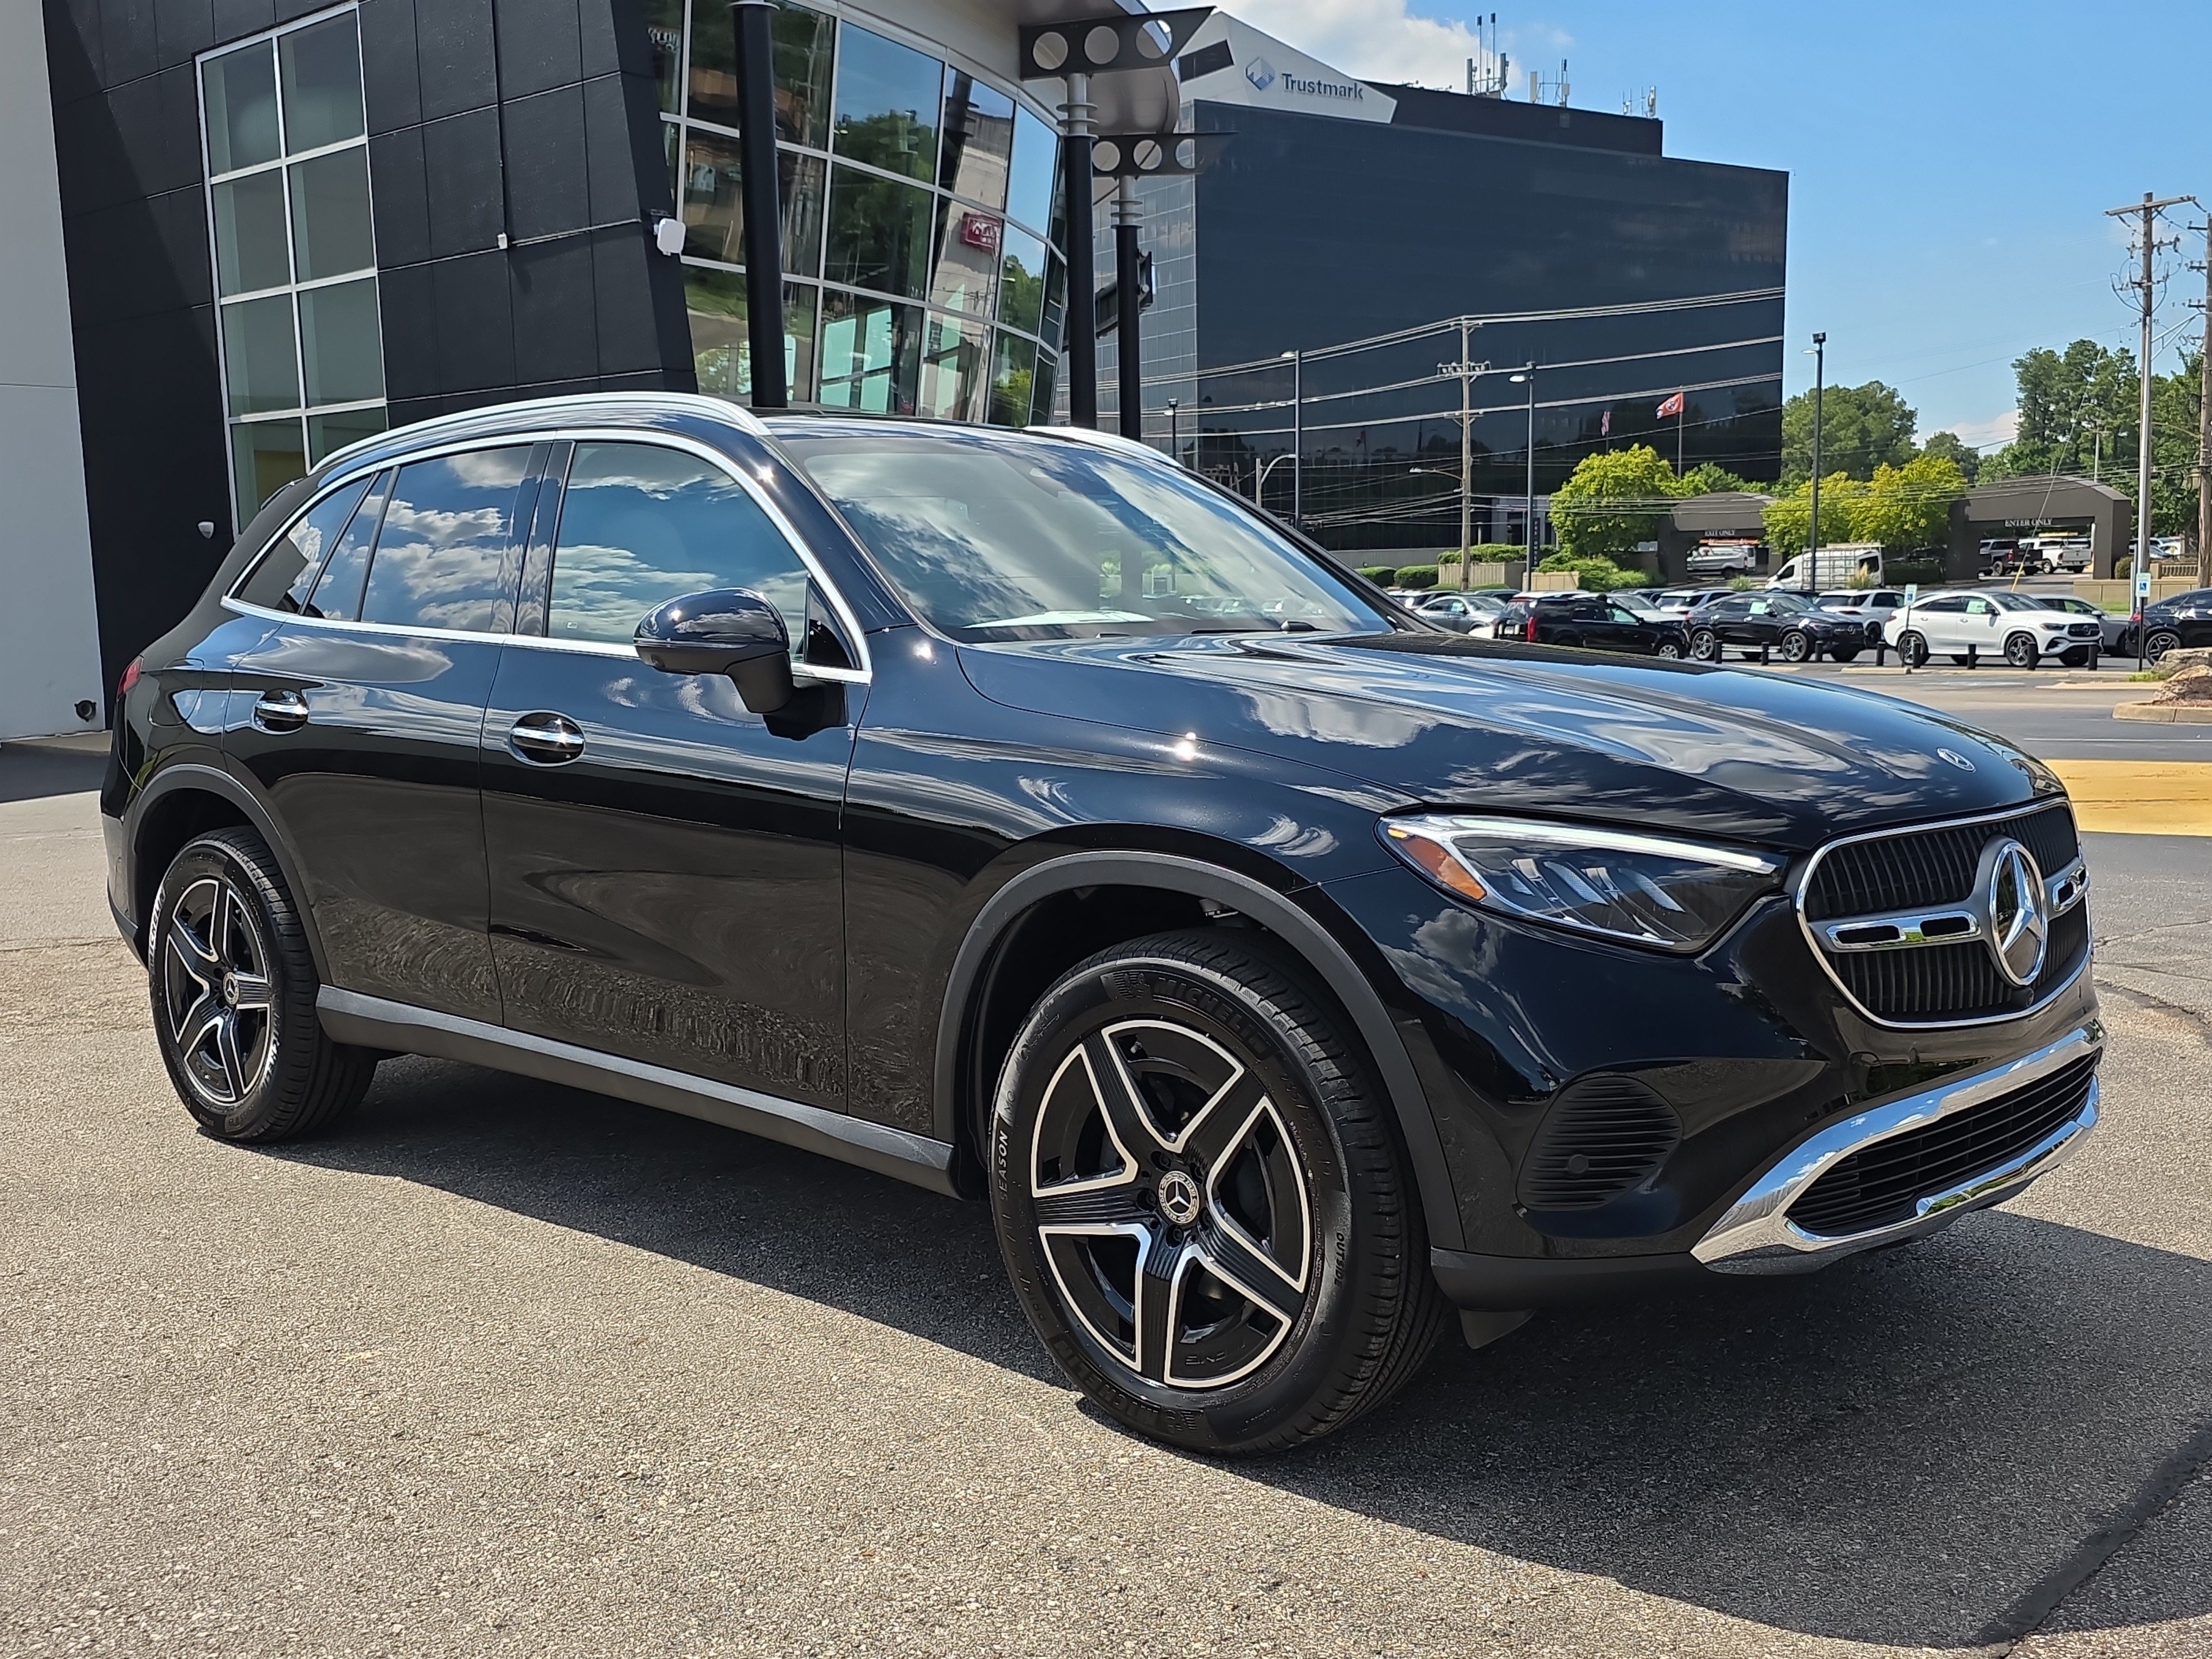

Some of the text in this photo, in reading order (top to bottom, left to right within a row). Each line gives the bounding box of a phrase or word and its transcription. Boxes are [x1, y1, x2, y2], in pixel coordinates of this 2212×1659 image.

[1281, 73, 1364, 100] Trustmark
[1154, 976, 1272, 1057] MICHELIN
[998, 1129, 1008, 1201] SEASON
[1334, 1232, 1346, 1289] OUTSIDE
